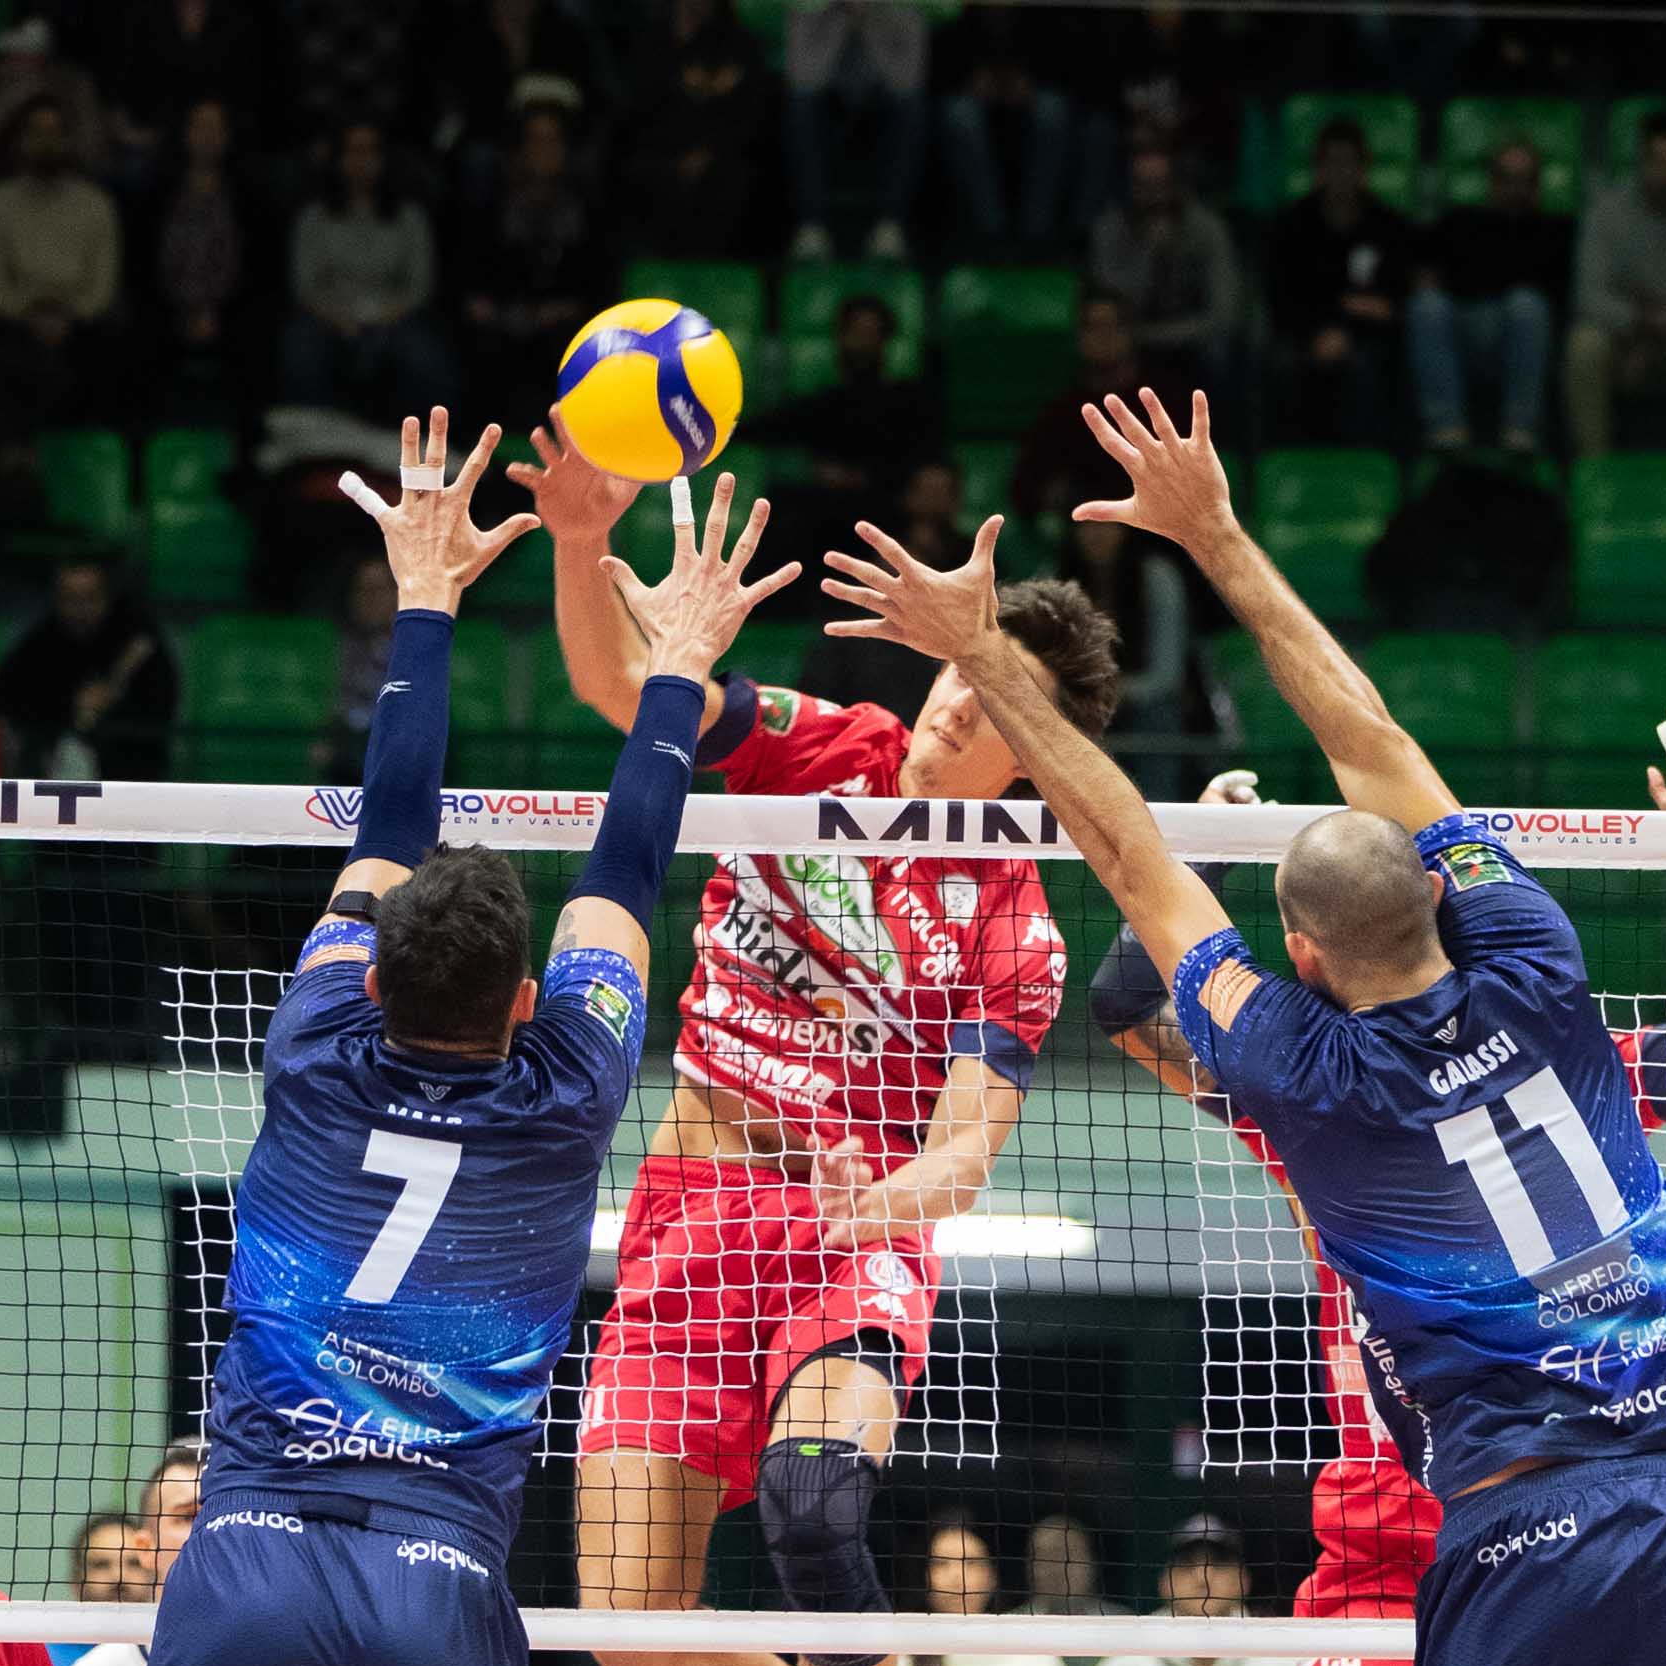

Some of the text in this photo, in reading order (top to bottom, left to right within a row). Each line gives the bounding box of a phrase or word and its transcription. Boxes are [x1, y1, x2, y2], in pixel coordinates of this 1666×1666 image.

[441, 794, 609, 816] ROVOLLE
[492, 817, 513, 825] BY
[528, 817, 595, 827] VALUE
[818, 798, 1060, 845] MIN
[1473, 814, 1645, 834] OVOLLEY
[1521, 835, 1637, 845] BY VALUES
[1429, 1030, 1520, 1095] GALASSI
[1434, 1064, 1631, 1277] 11
[344, 1128, 462, 1304] 7
[1538, 1253, 1644, 1309] ALFREDO
[1538, 1277, 1650, 1329] COLOMBO
[316, 1351, 443, 1398] COLOMBO
[1478, 1513, 1577, 1568] opiquad
